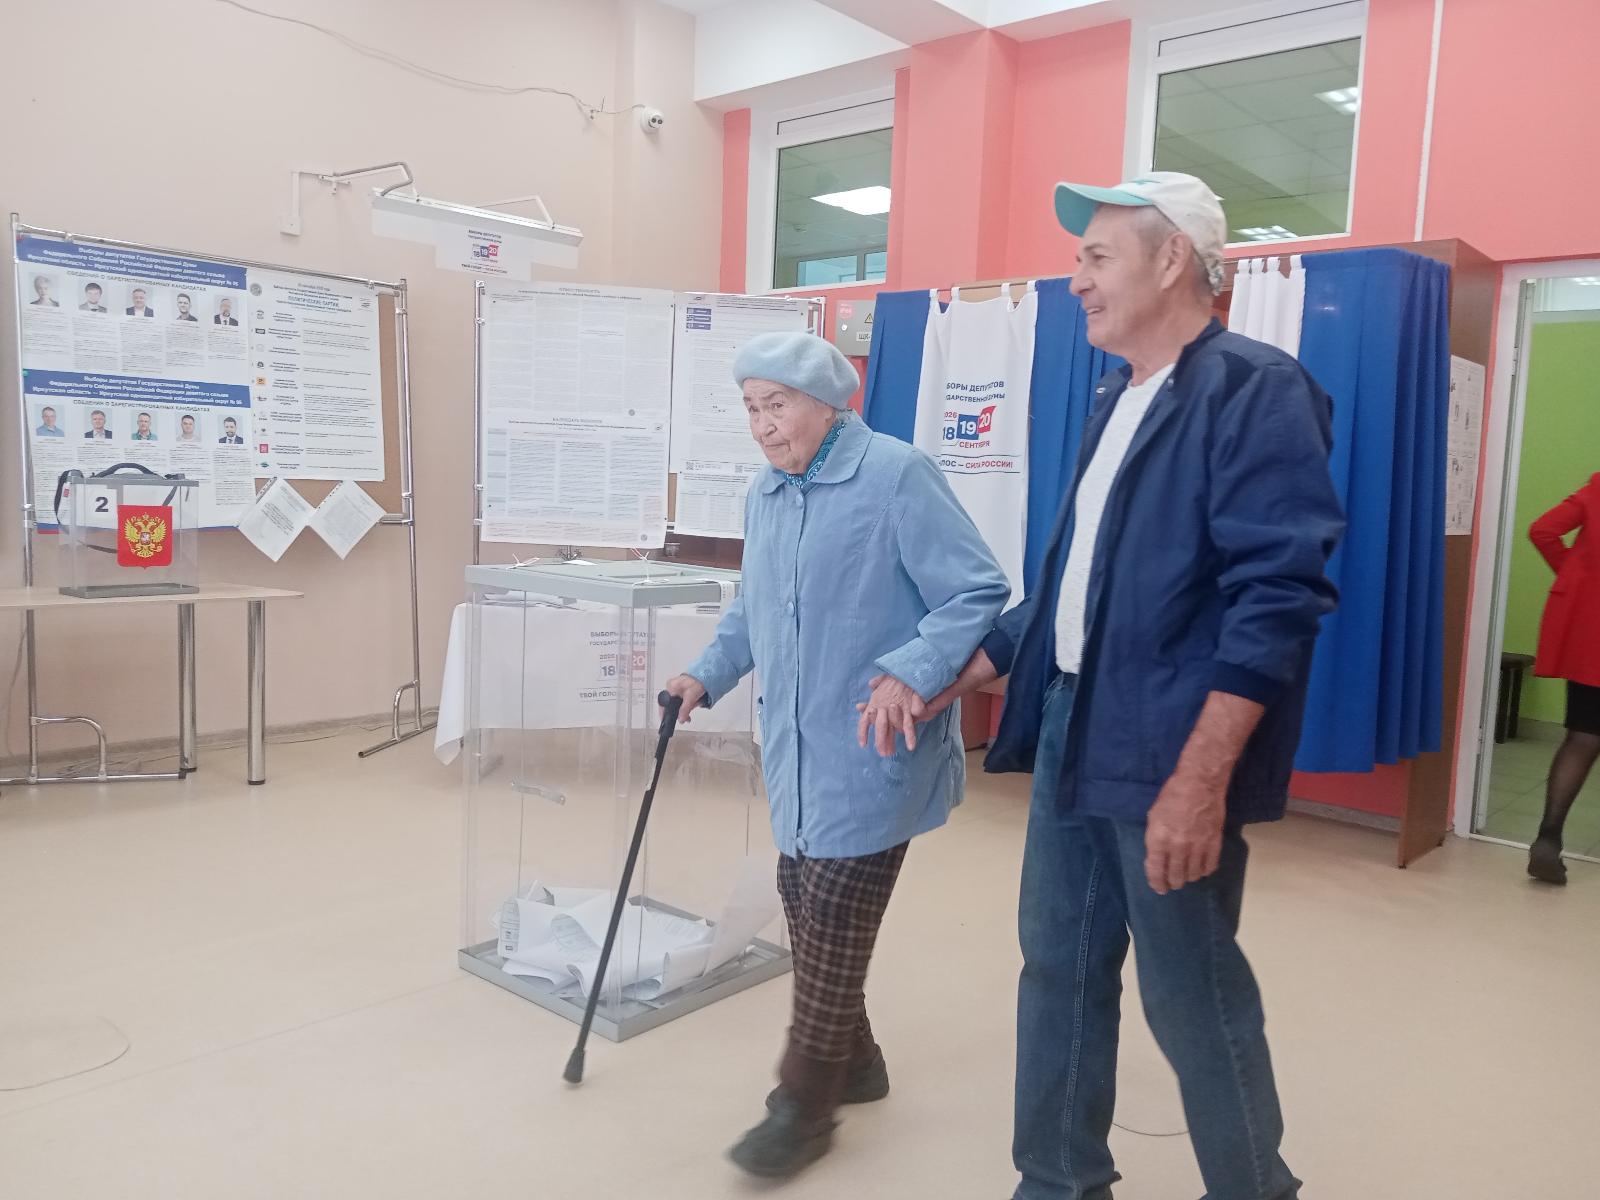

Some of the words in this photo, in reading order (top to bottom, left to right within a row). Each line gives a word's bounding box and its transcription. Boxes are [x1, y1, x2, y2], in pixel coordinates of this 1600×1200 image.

[946, 382, 968, 391] БОРЫ
[960, 420, 977, 435] 19
[979, 413, 990, 428] 20
[95, 496, 109, 512] 2
[602, 665, 615, 676] 18
